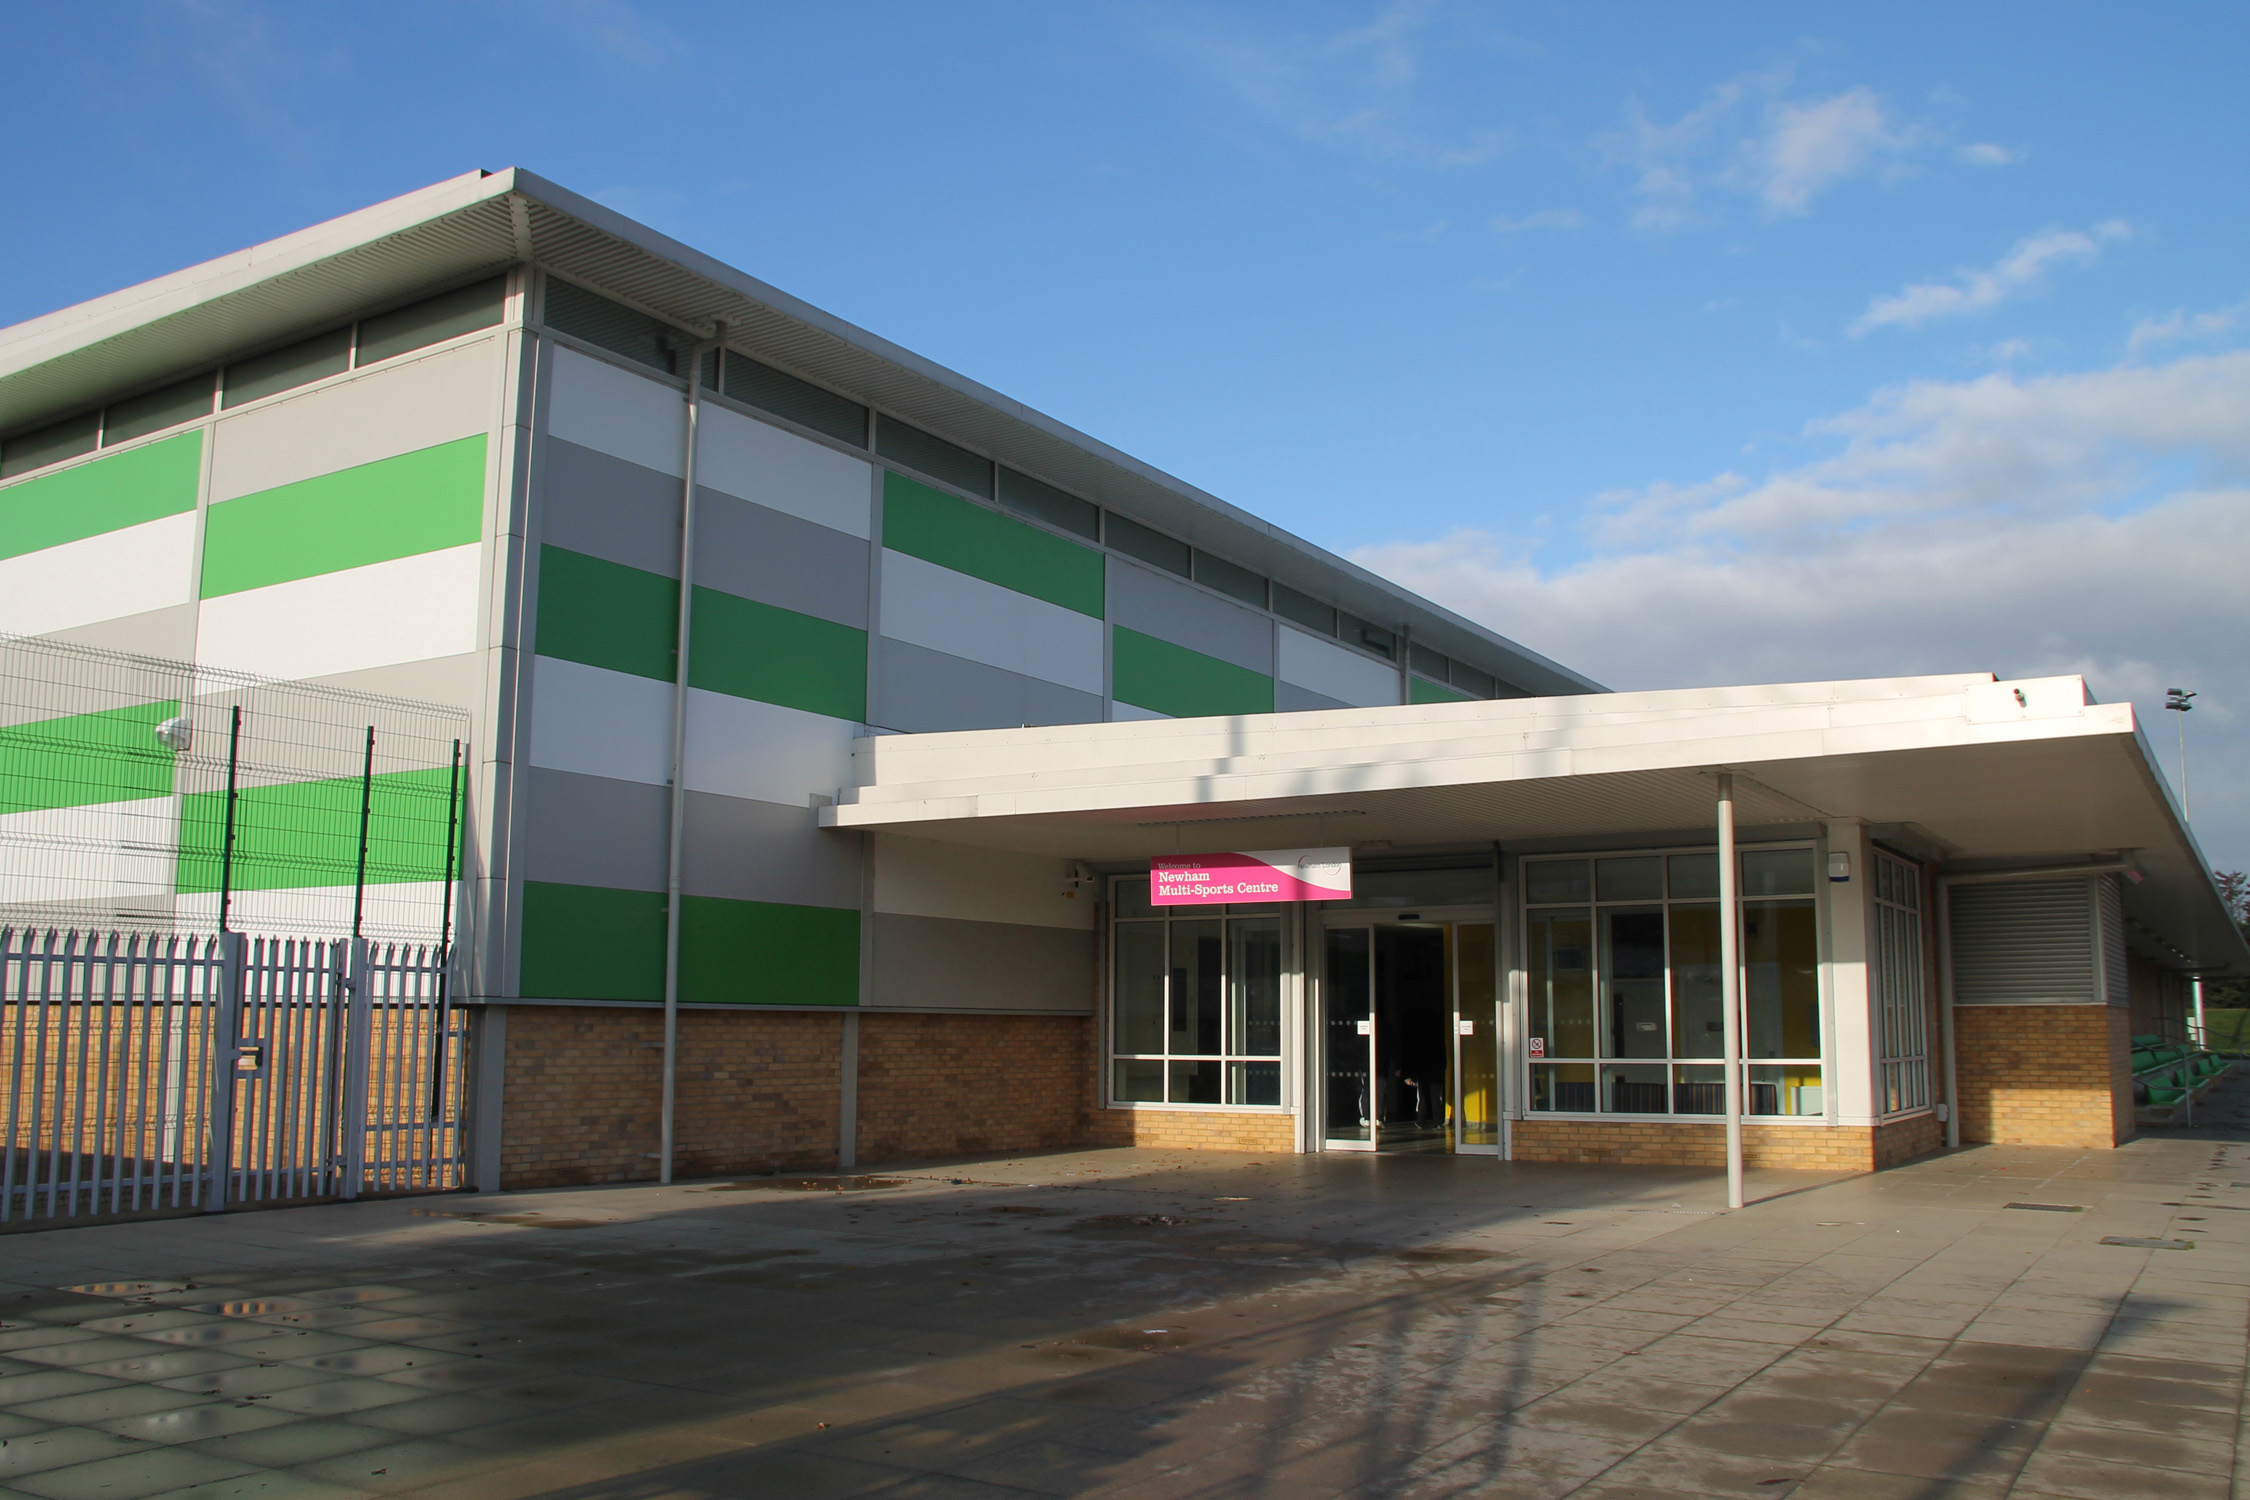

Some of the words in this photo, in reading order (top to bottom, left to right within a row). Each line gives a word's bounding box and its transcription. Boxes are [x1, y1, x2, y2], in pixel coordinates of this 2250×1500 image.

[1158, 871, 1210, 882] Newham
[1159, 883, 1234, 897] Multi-Sports
[1237, 882, 1278, 893] Centre
